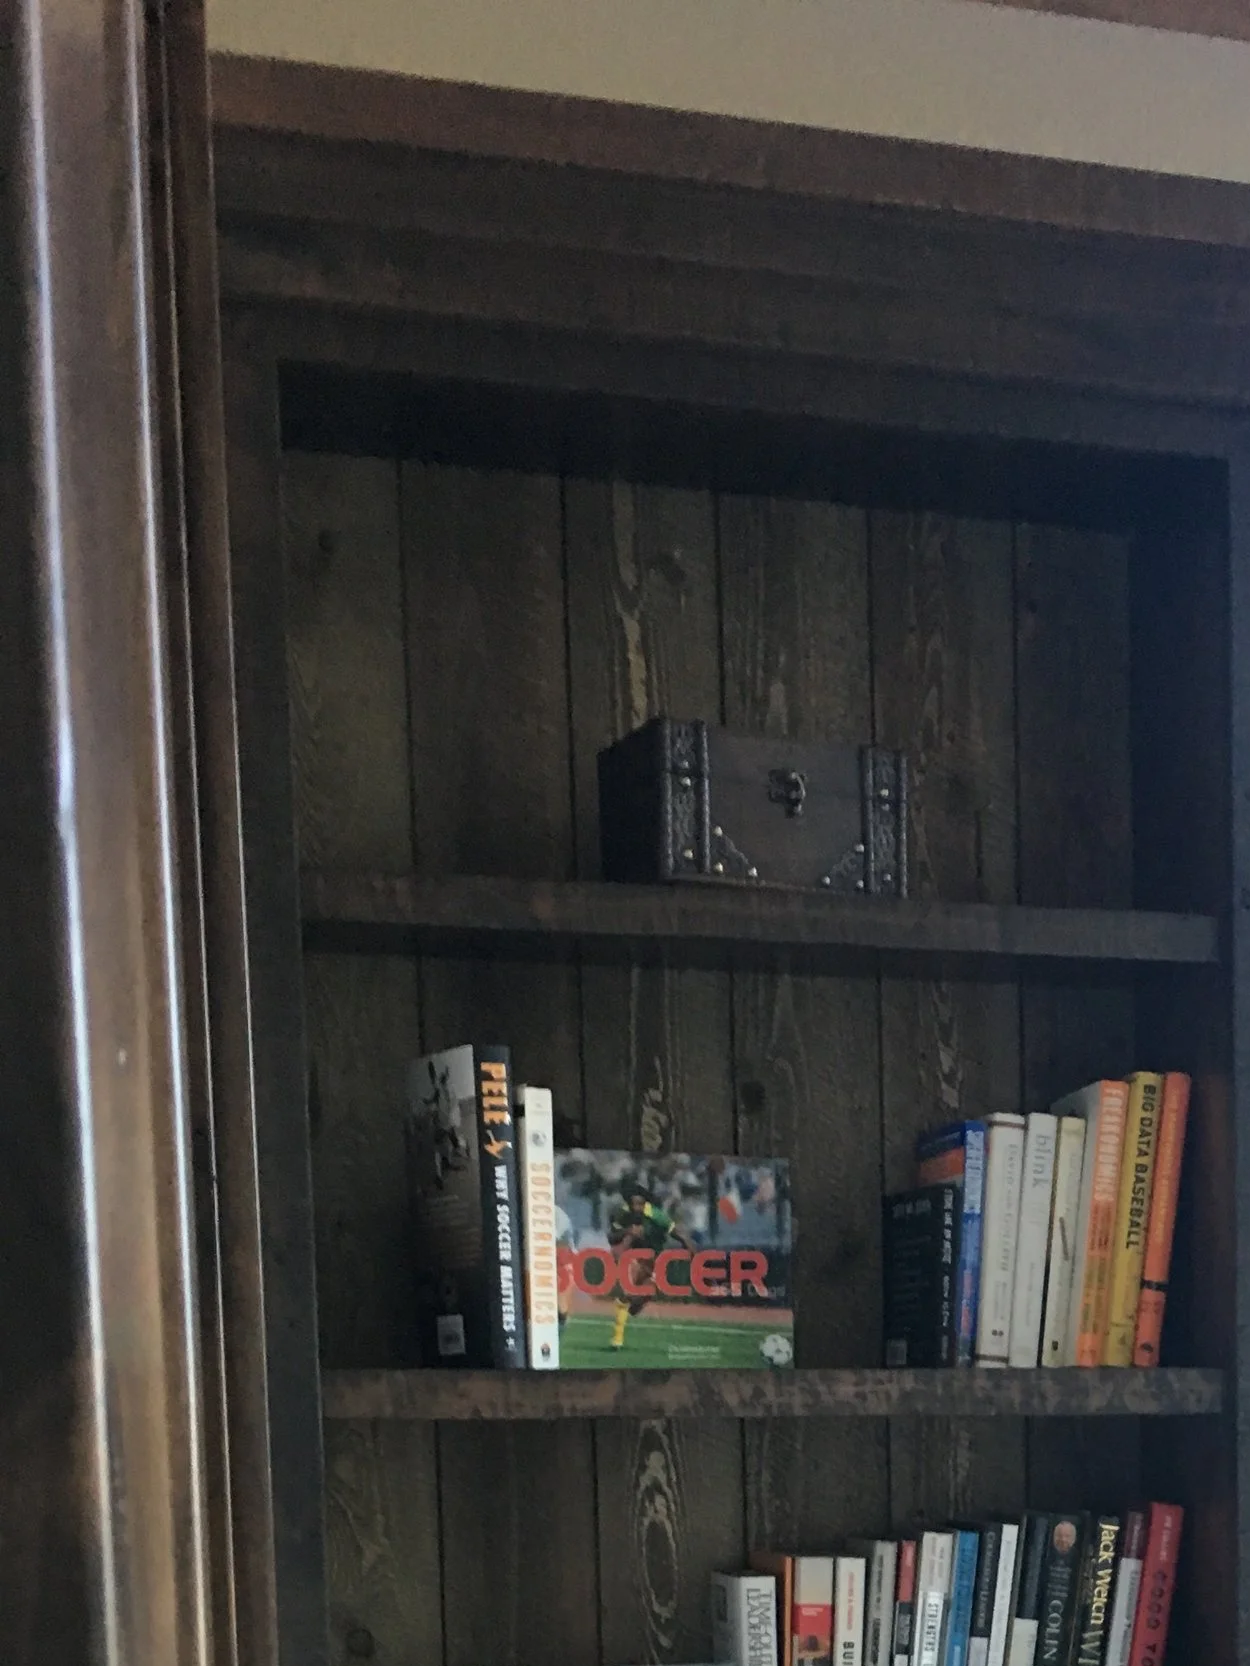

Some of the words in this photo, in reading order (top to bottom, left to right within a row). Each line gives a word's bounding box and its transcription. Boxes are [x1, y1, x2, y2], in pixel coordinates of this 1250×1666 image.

[1141, 1084, 1157, 1112] BIG
[1031, 1133, 1053, 1189] blink
[1094, 1087, 1124, 1201] FREAKONOMICS
[1136, 1116, 1153, 1157] DATA
[496, 1204, 512, 1260] SOCCER
[1125, 1162, 1149, 1249] BASEBALL
[530, 1162, 555, 1325] SOCCERNOMICS
[499, 1265, 516, 1332] MATTERS
[1097, 1522, 1121, 1563] Jack
[1089, 1567, 1114, 1625] Welch
[1146, 1569, 1168, 1631] GOOD
[1043, 1599, 1063, 1660] COLIN
